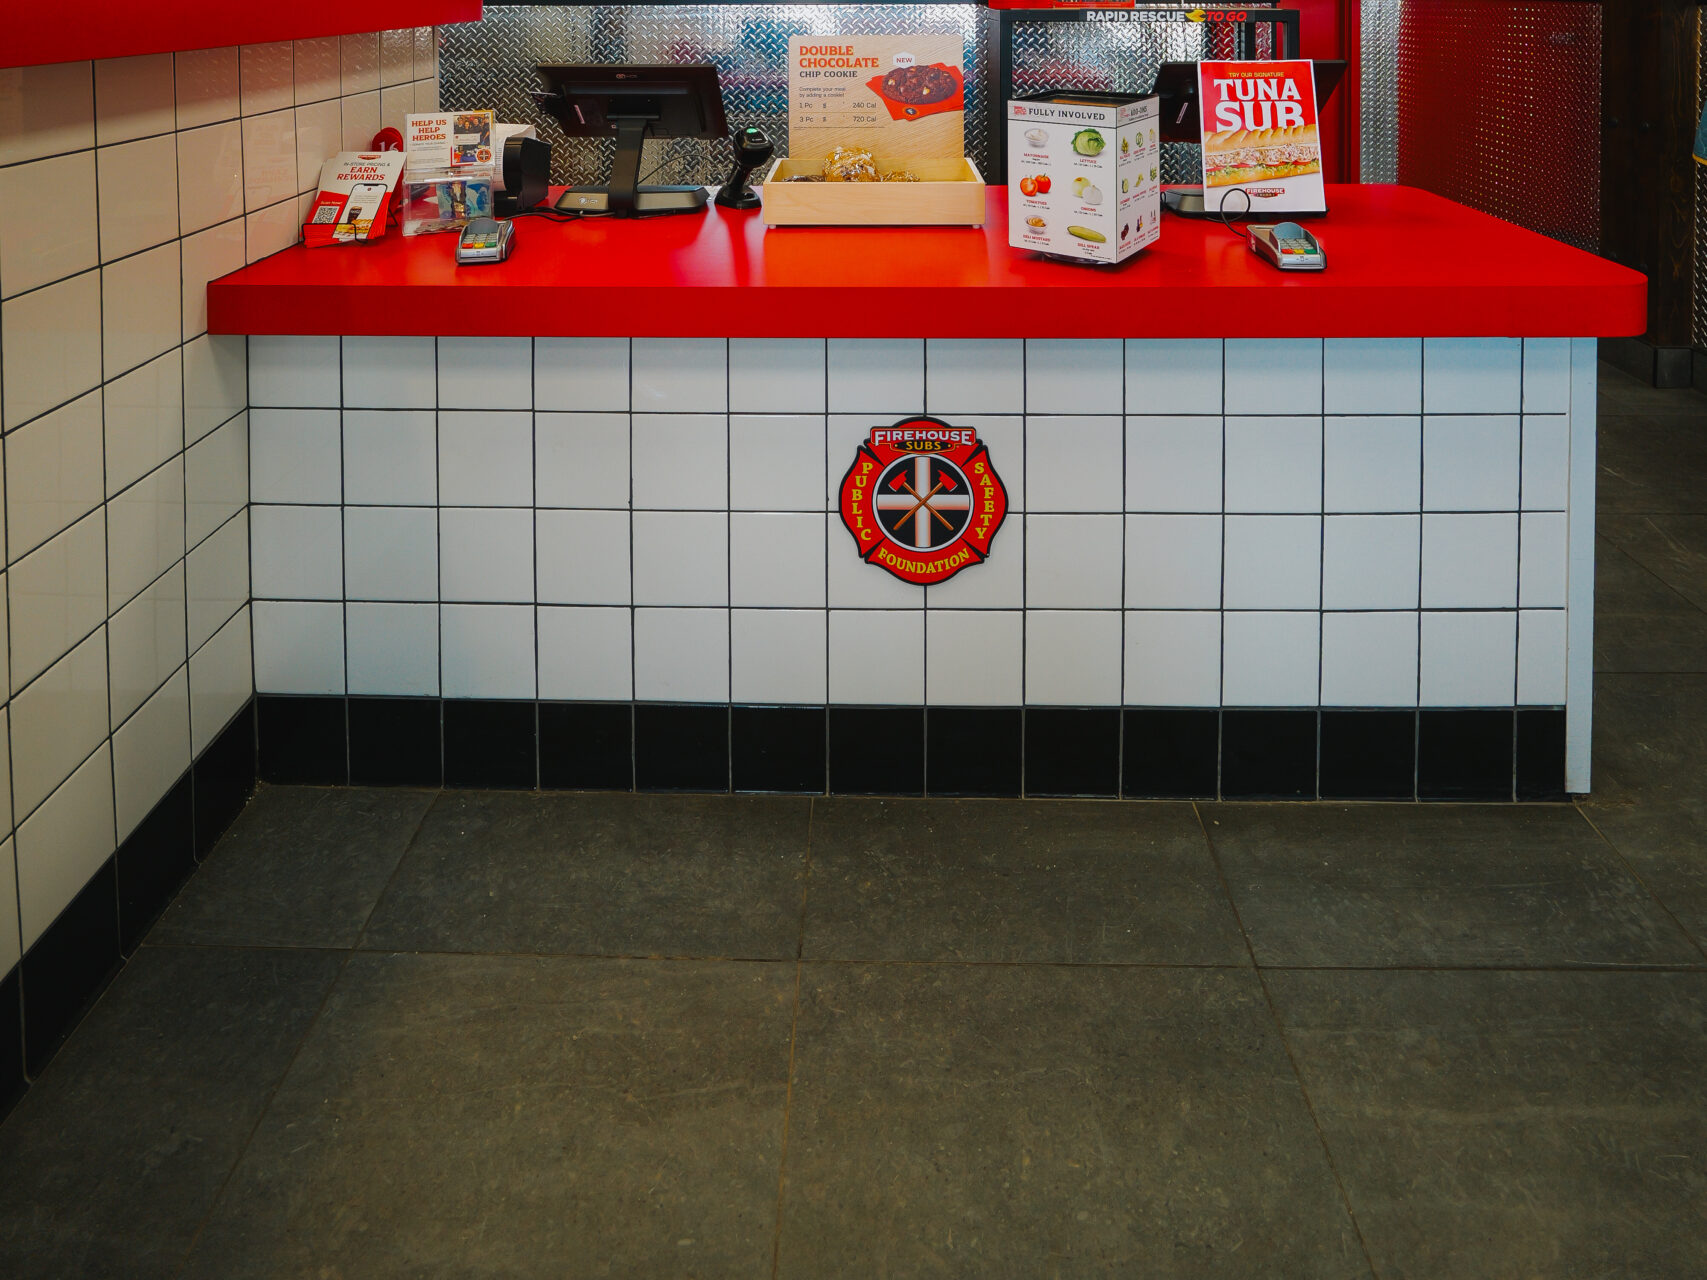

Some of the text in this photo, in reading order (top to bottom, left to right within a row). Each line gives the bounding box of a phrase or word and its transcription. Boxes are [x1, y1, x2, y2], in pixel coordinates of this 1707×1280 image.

[1086, 11, 1247, 22] RAPID RESCUE TO GO
[799, 45, 854, 56] DOUBLE
[799, 57, 879, 68] CHOCOLATE
[823, 70, 858, 78] COOKIE
[1213, 78, 1302, 101] TUNA
[1028, 108, 1055, 118] FULLY
[1058, 111, 1106, 121] INVOLVED
[1215, 100, 1305, 133] SUB
[411, 118, 447, 127] HELP US
[412, 133, 447, 142] HEROES
[336, 173, 386, 181] REWARDS
[874, 430, 973, 446] FIREHOUSE
[905, 440, 942, 451] SUBS
[851, 462, 874, 541] PUBLIC
[974, 462, 995, 540] SAFETY
[878, 547, 970, 574] FOUNDATION
